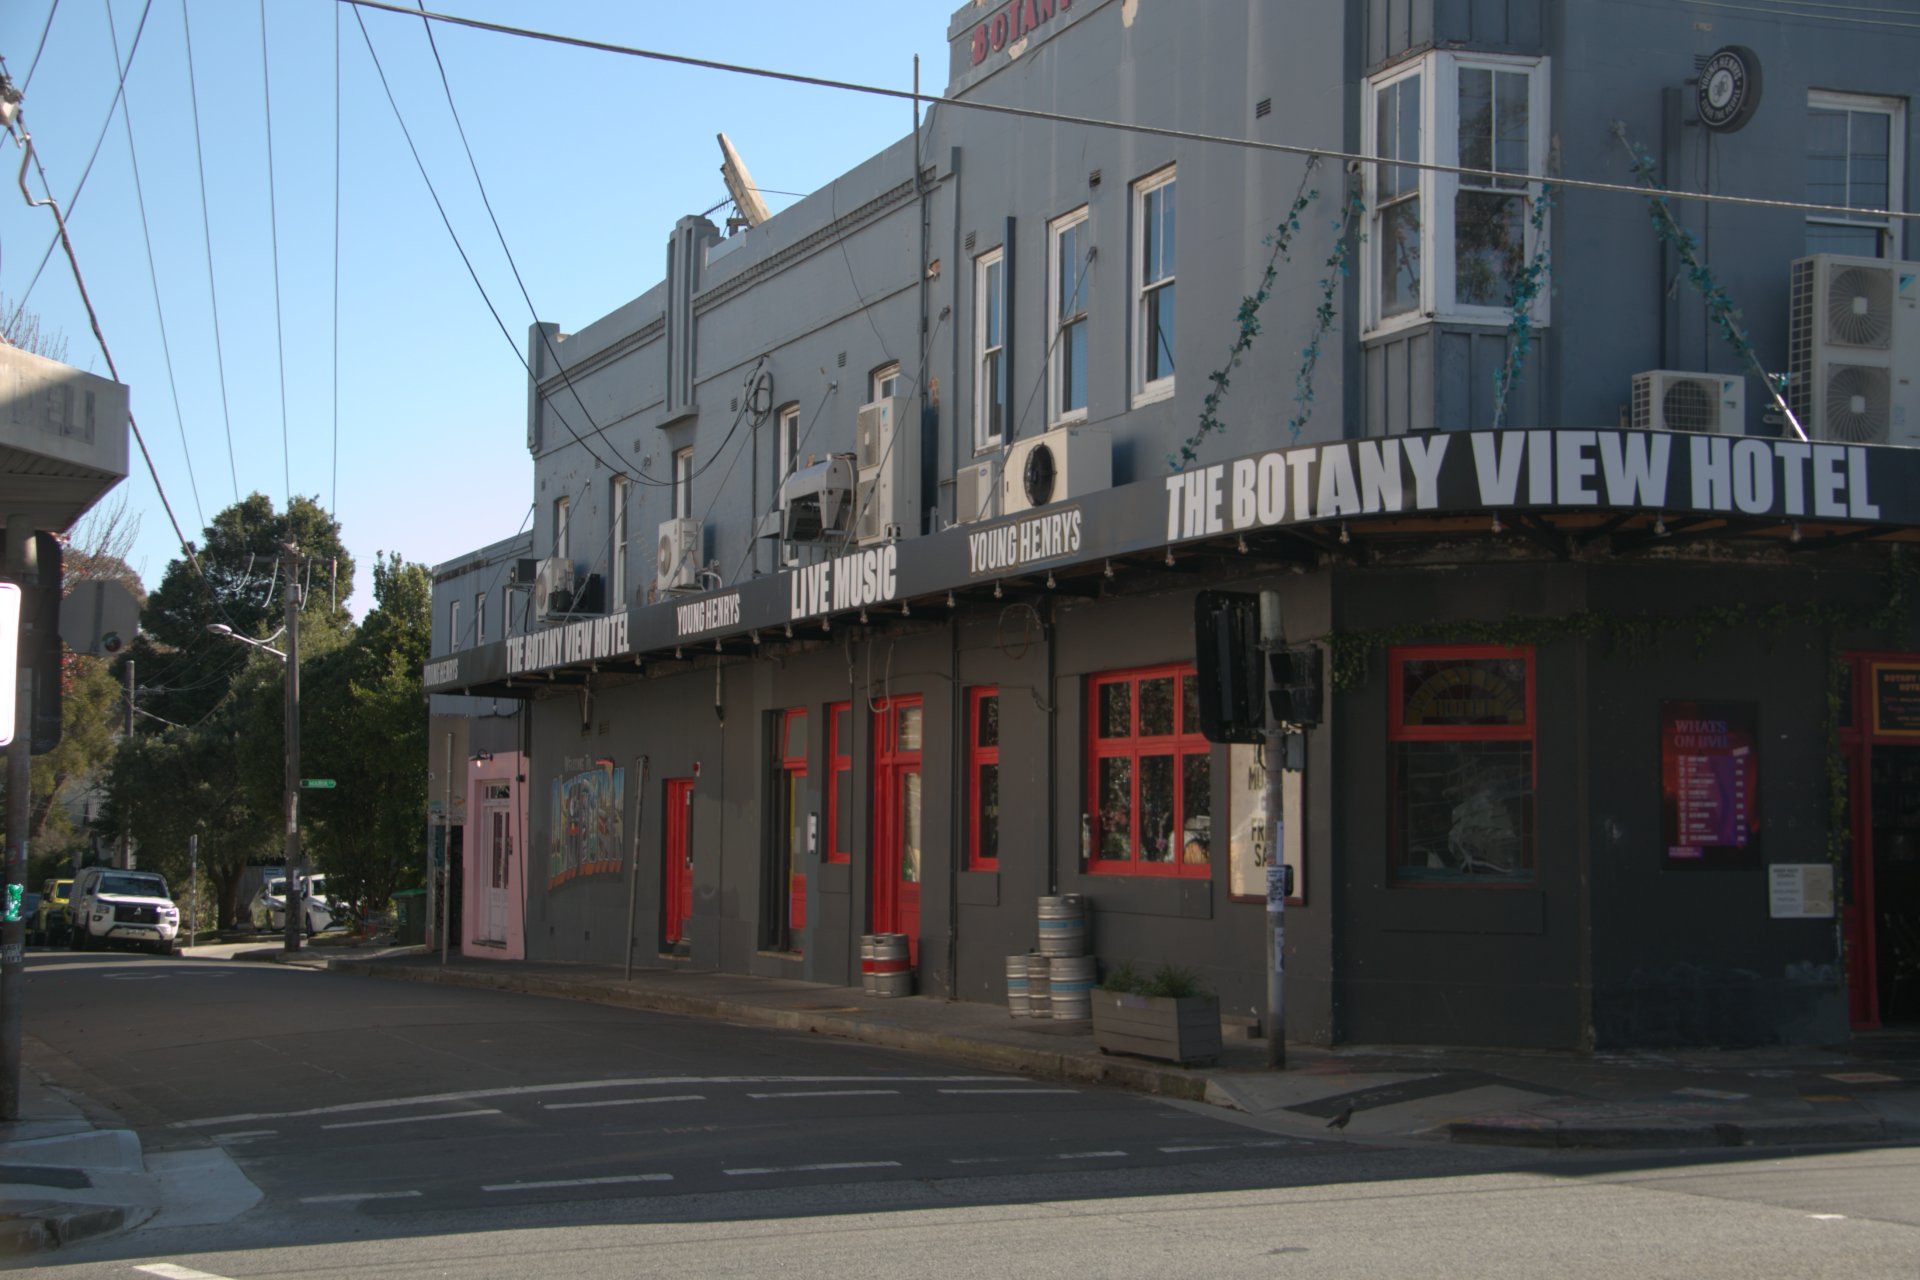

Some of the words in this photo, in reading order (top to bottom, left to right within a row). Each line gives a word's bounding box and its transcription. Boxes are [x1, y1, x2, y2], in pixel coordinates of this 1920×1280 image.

[971, 0, 1070, 65] BOTAN
[1701, 60, 1719, 90] YOUNG
[1718, 56, 1742, 81] HENRYS
[1165, 464, 1224, 541] THE
[1231, 433, 1451, 531] BOTANY
[1470, 430, 1672, 507] VIEW
[1689, 435, 1881, 520] HOTEL
[968, 525, 1018, 574] YOUNG
[1018, 509, 1082, 563] HENRYS
[676, 601, 705, 637] YOUNG
[704, 592, 741, 631] HENRYS
[790, 560, 831, 620] LIVE
[832, 544, 897, 611] MUSIC
[505, 636, 524, 675] THE
[524, 626, 564, 671] BOTANY
[563, 619, 594, 664] VIEW
[593, 610, 630, 659] HOTEL
[1673, 735, 1696, 748] ON
